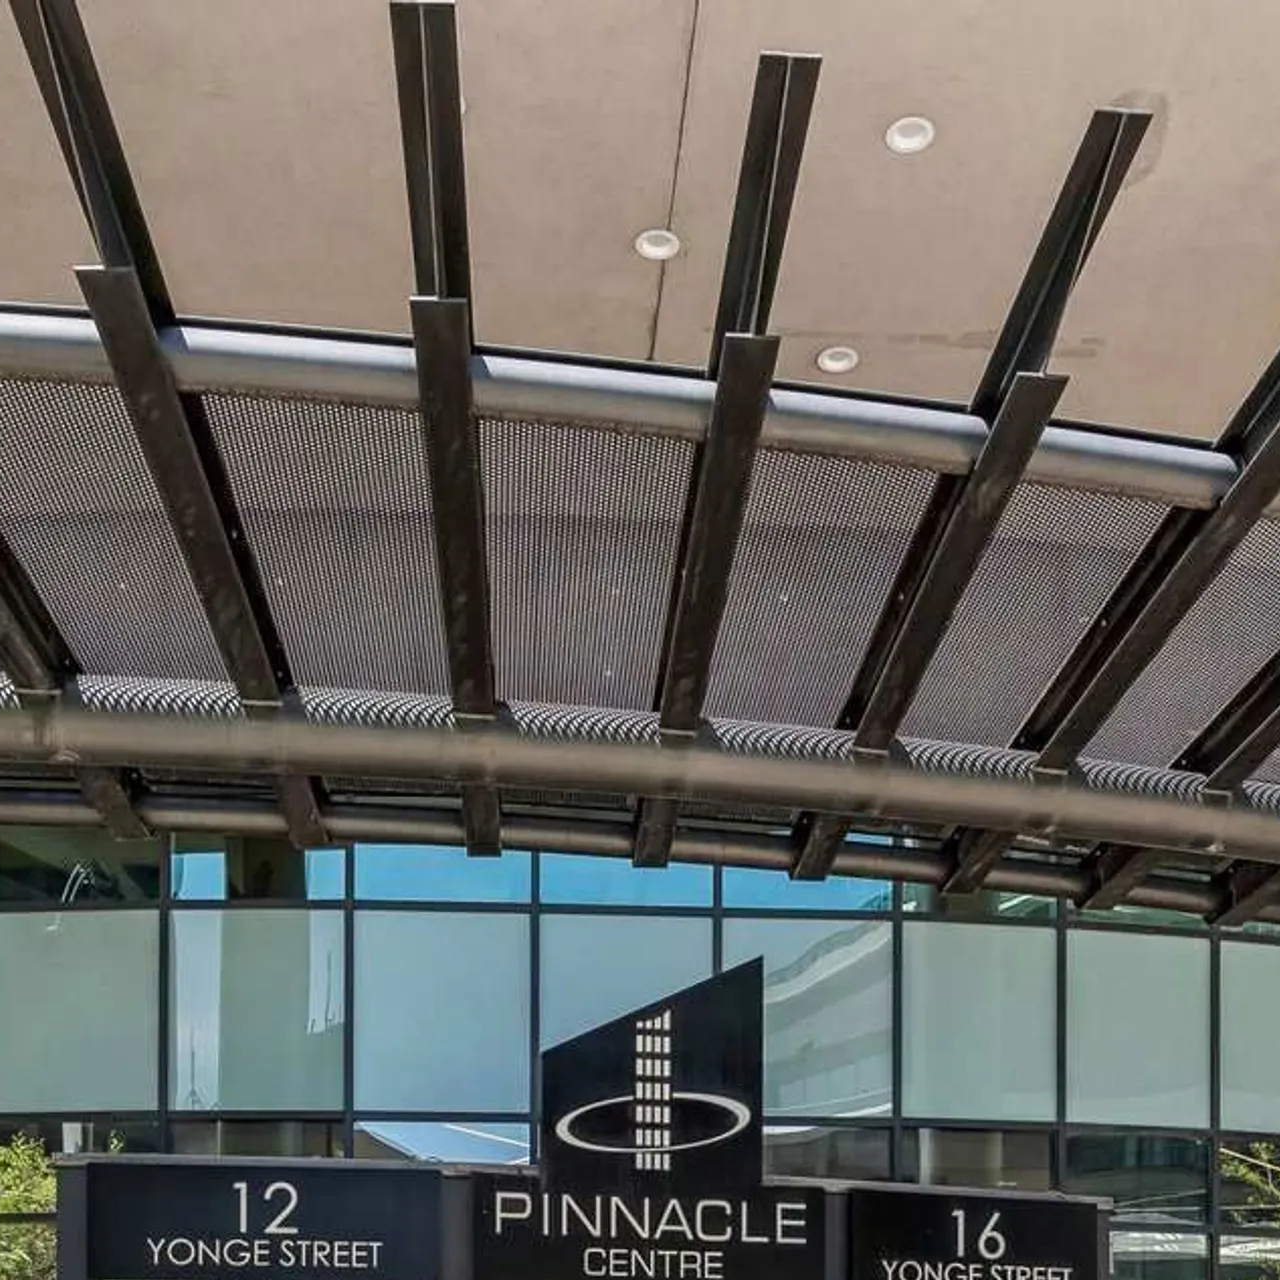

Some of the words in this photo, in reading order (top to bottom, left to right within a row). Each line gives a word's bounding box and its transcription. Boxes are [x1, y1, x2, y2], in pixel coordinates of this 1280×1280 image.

[232, 1181, 299, 1235] 12
[494, 1190, 808, 1245] PINNACLE
[950, 1208, 1007, 1260] 16
[146, 1237, 271, 1268] YONGE
[278, 1239, 384, 1269] STREET
[582, 1247, 725, 1280] CENTRE
